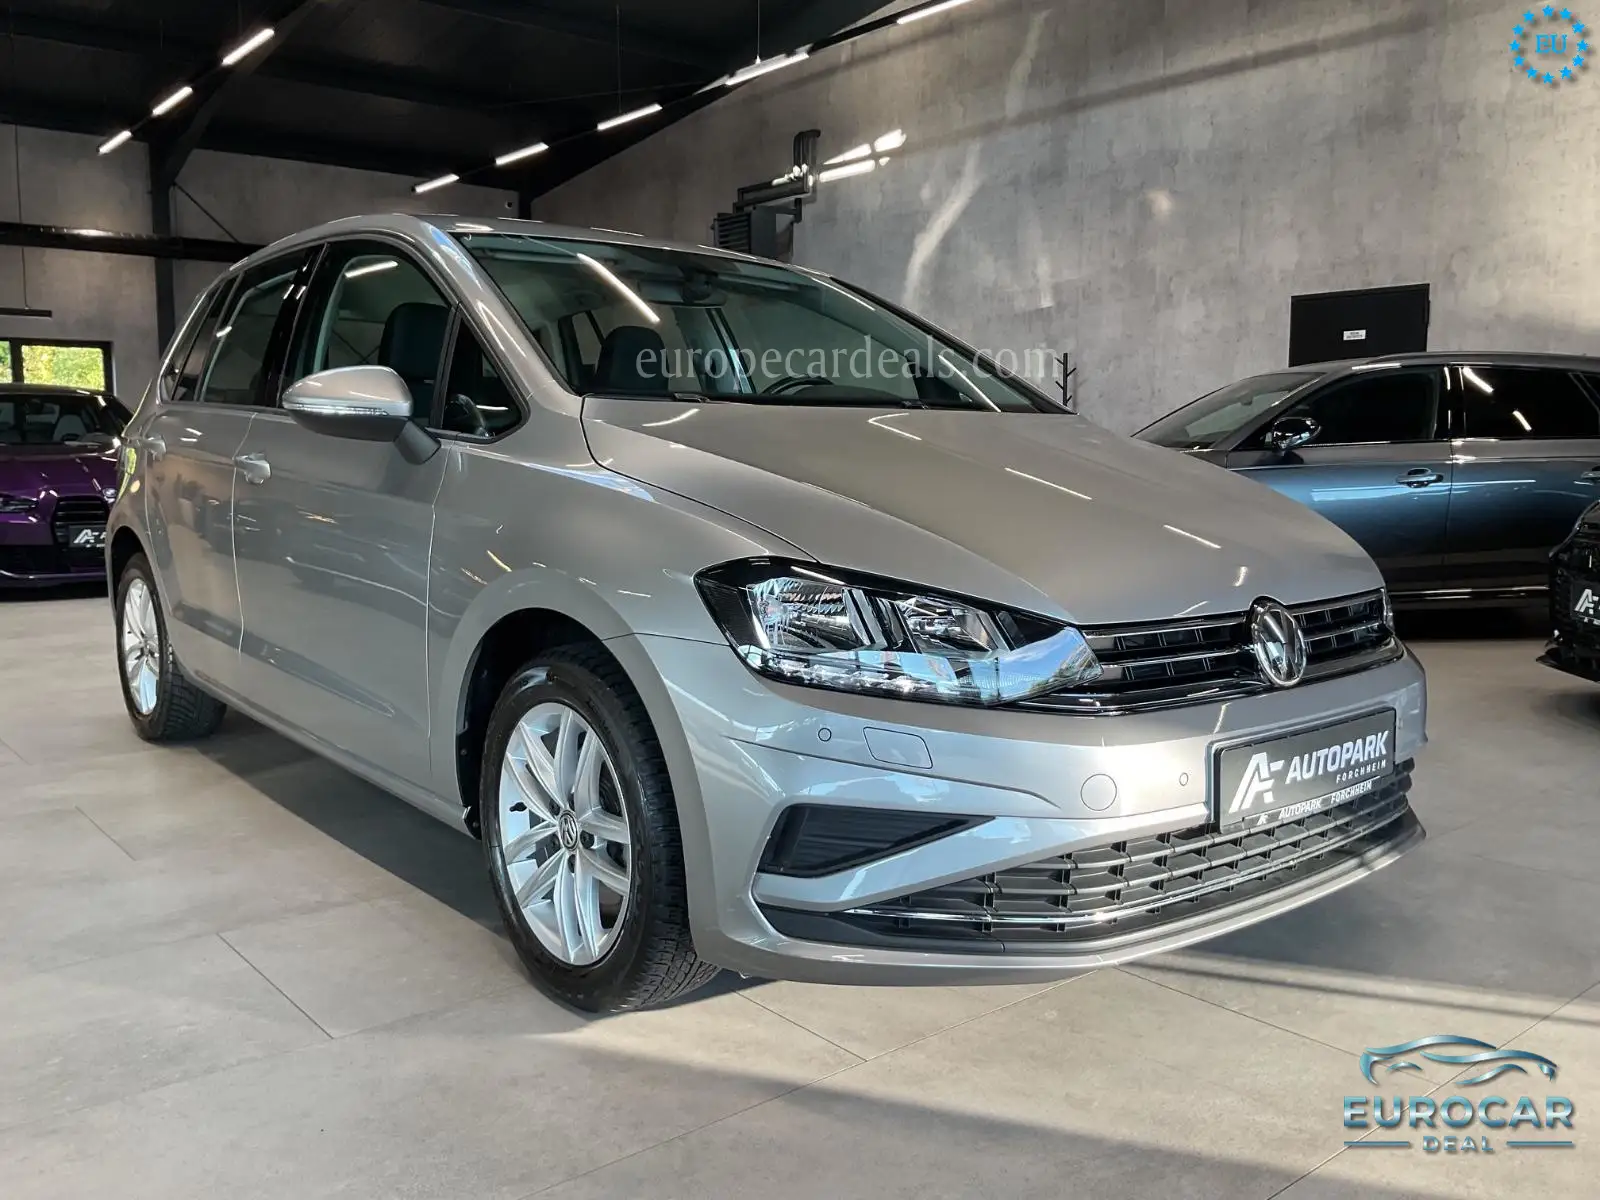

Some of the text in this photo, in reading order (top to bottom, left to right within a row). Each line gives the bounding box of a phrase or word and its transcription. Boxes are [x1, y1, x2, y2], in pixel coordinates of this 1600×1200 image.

[1285, 730, 1389, 785] AUTOPARK
[1336, 759, 1387, 784] FORCHHEIM
[1278, 798, 1322, 820] AUTOPARK
